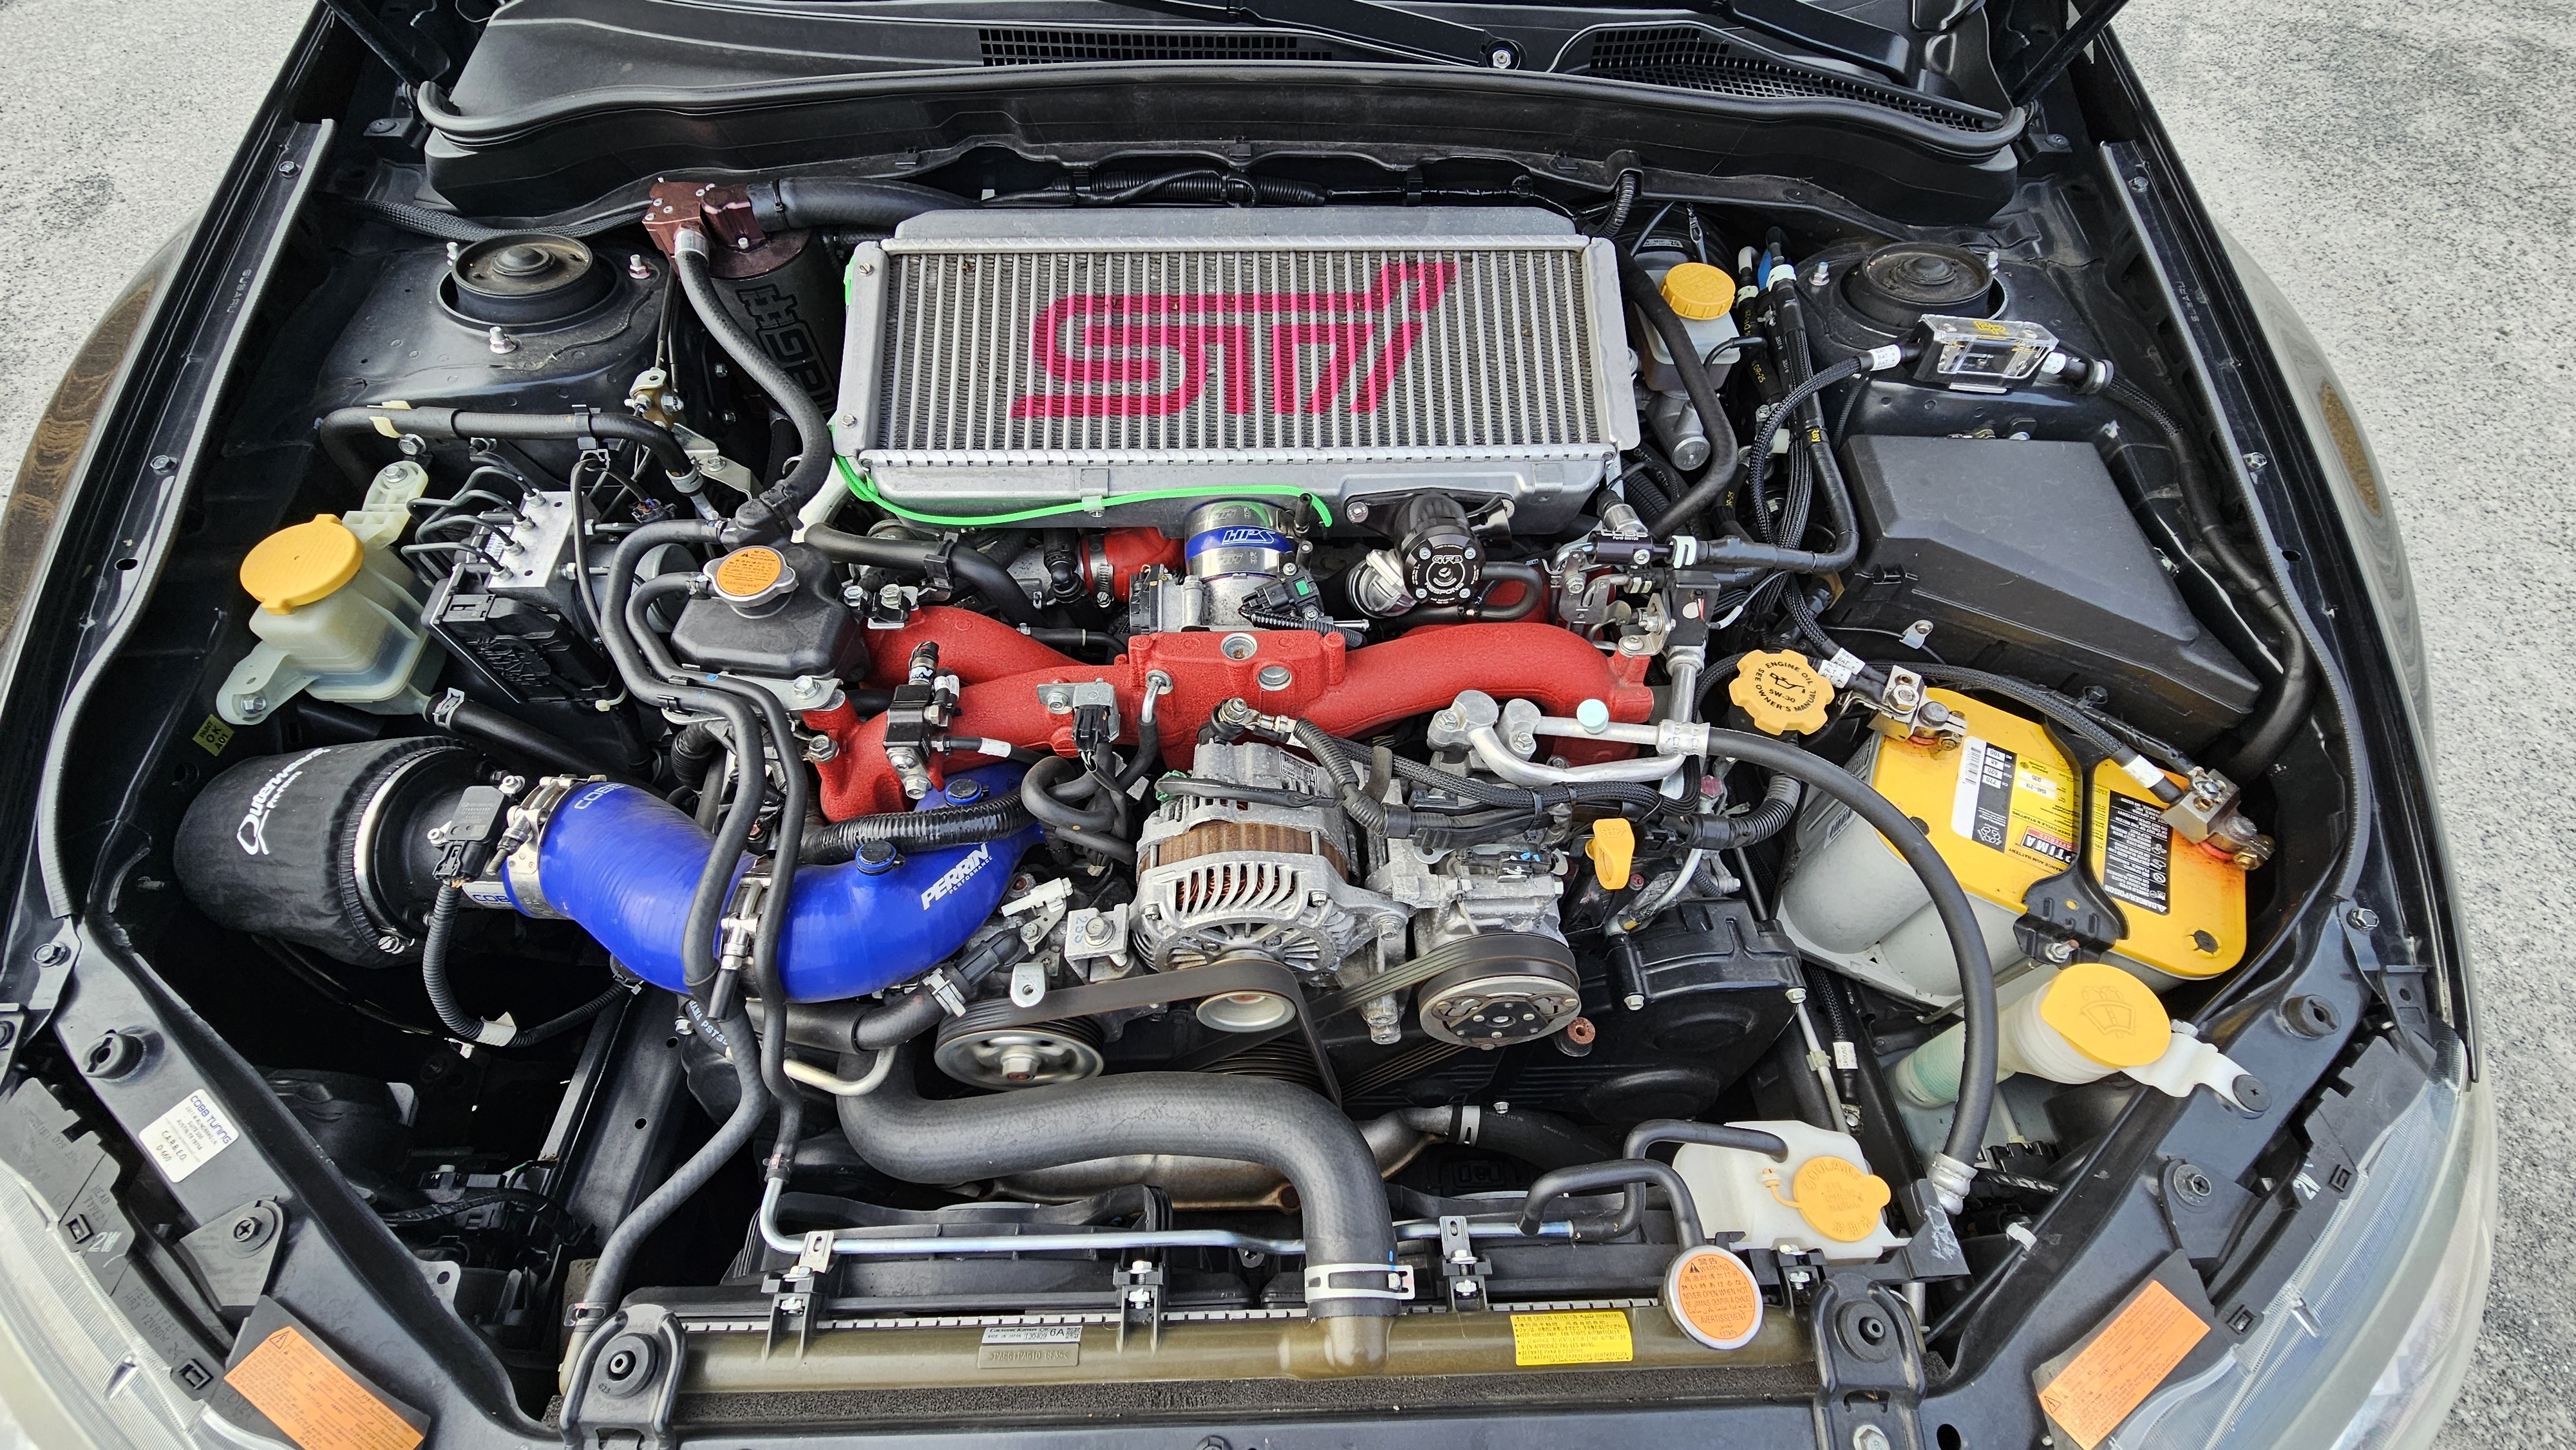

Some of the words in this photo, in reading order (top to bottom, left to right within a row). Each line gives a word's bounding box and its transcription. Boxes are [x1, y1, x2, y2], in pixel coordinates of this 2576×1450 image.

[227, 269, 252, 313] SUBARU
[2175, 281, 2200, 321] SUBARU
[1974, 321, 2009, 335] BR
[1753, 364, 1766, 383] DR-25
[1222, 529, 1275, 545] HPS
[1432, 555, 1463, 564] GFB
[1838, 657, 1848, 665] BAT
[1842, 652, 1852, 660] BAT
[1755, 668, 1765, 682] SEE
[1765, 661, 1800, 672] ENGINE
[1802, 672, 1814, 685] OIL
[1756, 684, 1791, 712] OWNER'S
[1769, 689, 1795, 703] 5W-30
[1794, 690, 1817, 712] MANUAL
[206, 725, 222, 742] OK
[1989, 749, 2000, 757] 100
[2029, 760, 2045, 769] Controls
[2031, 764, 2048, 774] Johnson
[1985, 776, 1996, 785] 770
[2041, 821, 2056, 831] CYCLE
[2057, 827, 2070, 837] DEEP
[2008, 846, 2031, 860] BATTERY
[2031, 856, 2043, 865] AGM
[922, 843, 988, 910] PERRIN
[949, 856, 992, 894] PERFORMANCE
[2105, 883, 2157, 910] DANGER/POISON
[190, 1096, 209, 1116] COBB
[207, 1115, 232, 1144] TUNING
[1803, 1160, 1862, 1190] COOLANT
[91, 1184, 110, 1204] HEAD
[84, 1196, 106, 1221] TYPE2
[1700, 1264, 1730, 1273] WARNING
[131, 1286, 156, 1309] HEAD
[1683, 1292, 1701, 1300] NEVER
[1701, 1313, 1747, 1324] AVERTISSEMENT
